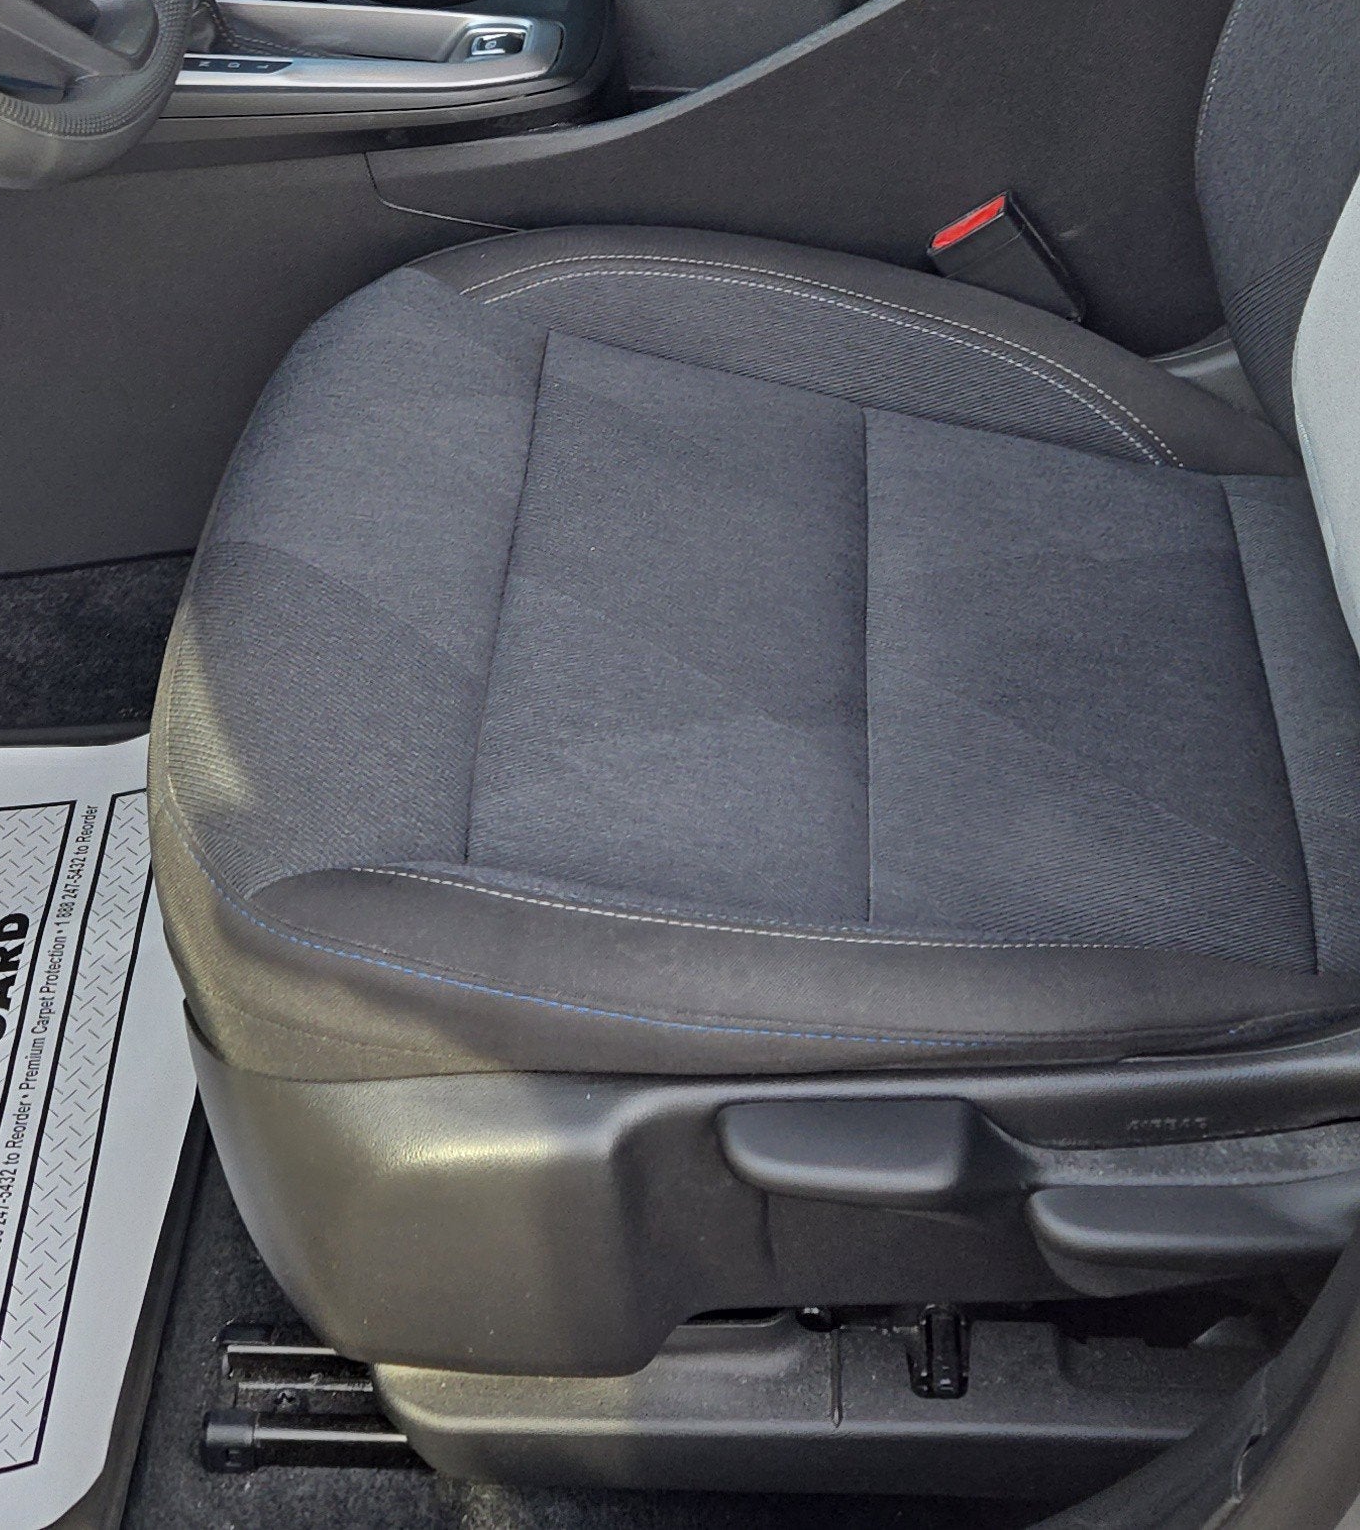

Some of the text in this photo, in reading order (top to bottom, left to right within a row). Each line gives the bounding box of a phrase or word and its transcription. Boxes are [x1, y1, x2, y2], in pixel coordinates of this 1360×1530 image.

[75, 805, 98, 844] Reorder
[75, 842, 88, 855] to
[62, 855, 86, 902] 247-5432
[56, 900, 72, 920] 888
[40, 935, 67, 997] Protection
[31, 996, 56, 1035] Carpet
[21, 1035, 45, 1092] Premium
[5, 1101, 31, 1150] Reorder
[4, 1149, 19, 1165] to
